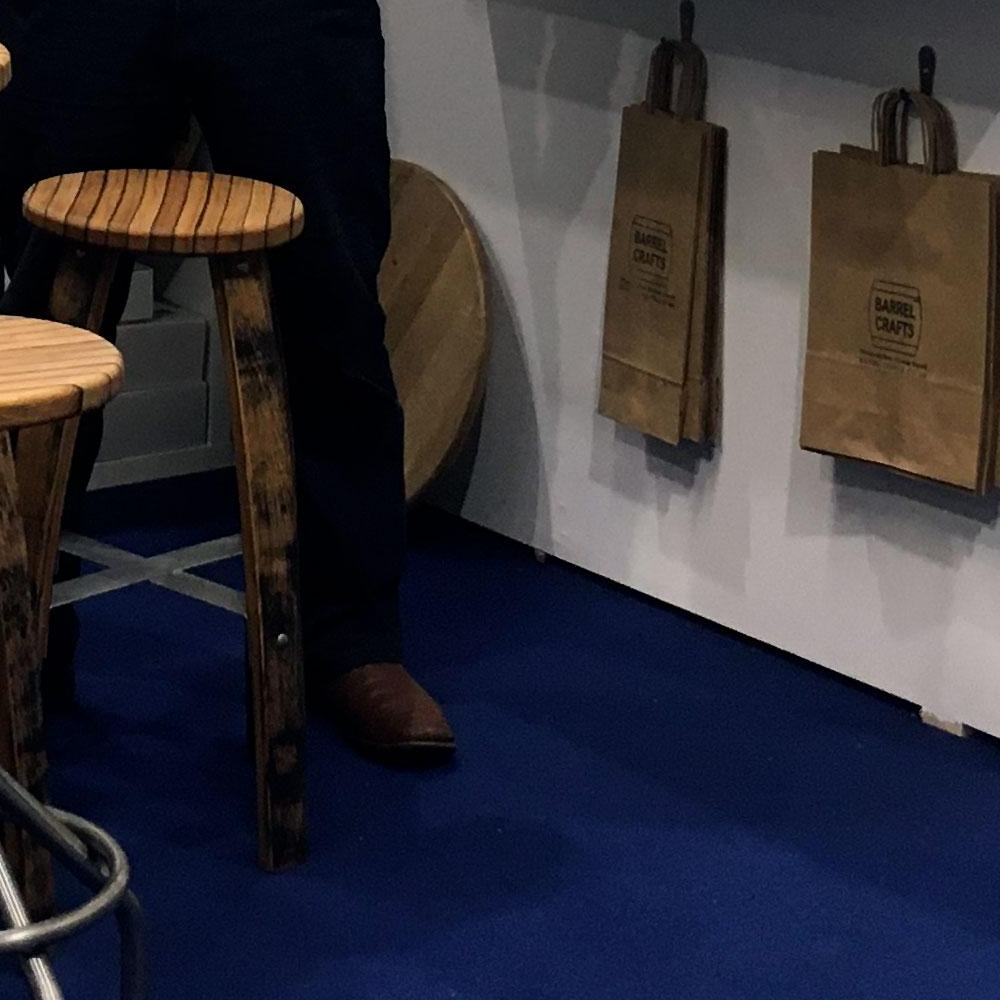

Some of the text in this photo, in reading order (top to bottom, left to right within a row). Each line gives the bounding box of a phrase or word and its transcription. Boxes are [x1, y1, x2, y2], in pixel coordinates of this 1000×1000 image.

[632, 247, 667, 271] CRAFTS
[874, 296, 916, 320] BARREL
[874, 315, 915, 339] CRAFTS
